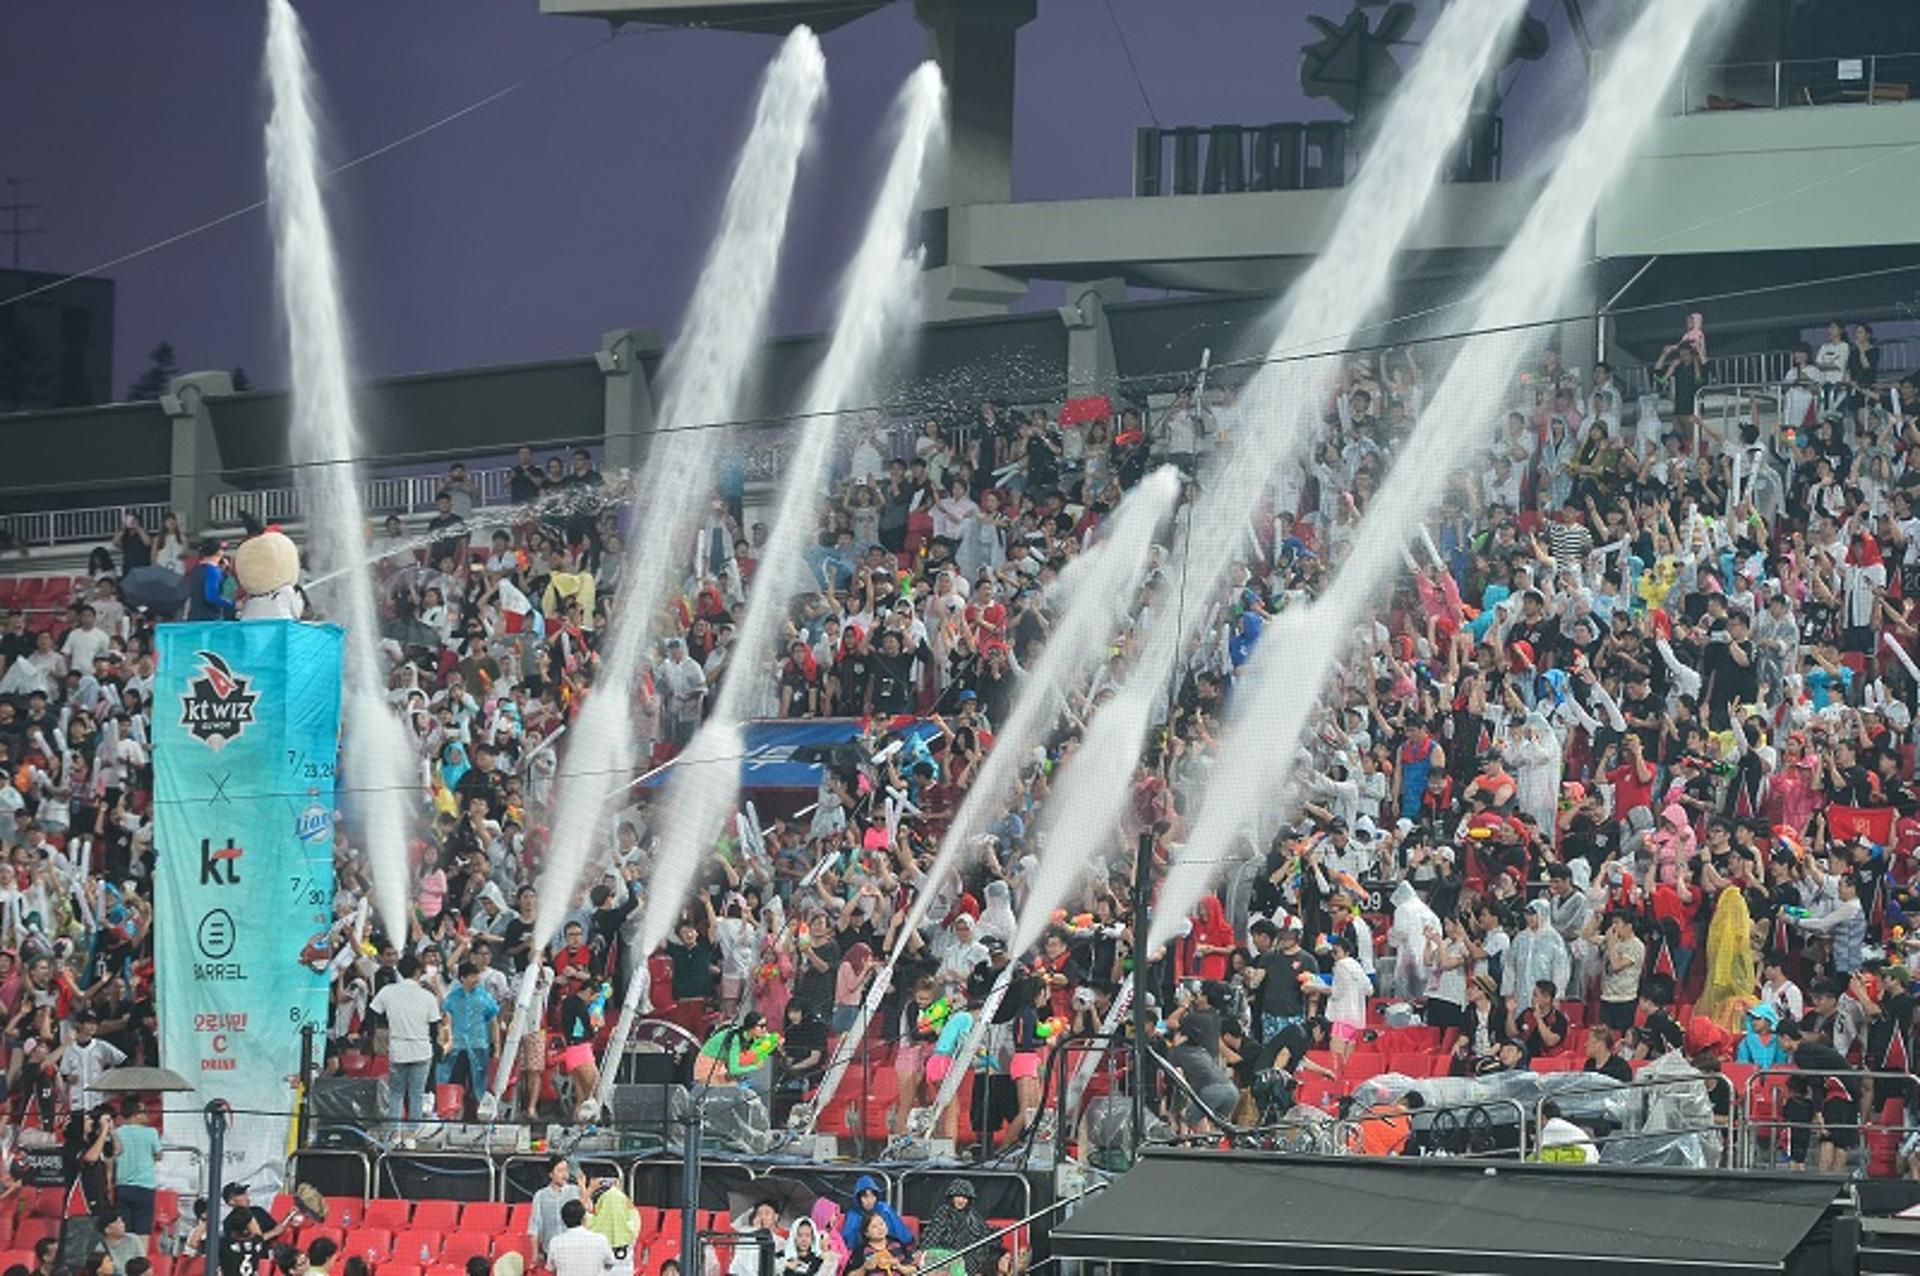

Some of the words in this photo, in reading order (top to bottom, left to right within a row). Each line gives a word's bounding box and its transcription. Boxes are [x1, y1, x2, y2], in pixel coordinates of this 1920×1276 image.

[189, 699, 209, 720] kt
[201, 838, 244, 886] kt
[212, 1034, 228, 1053] C
